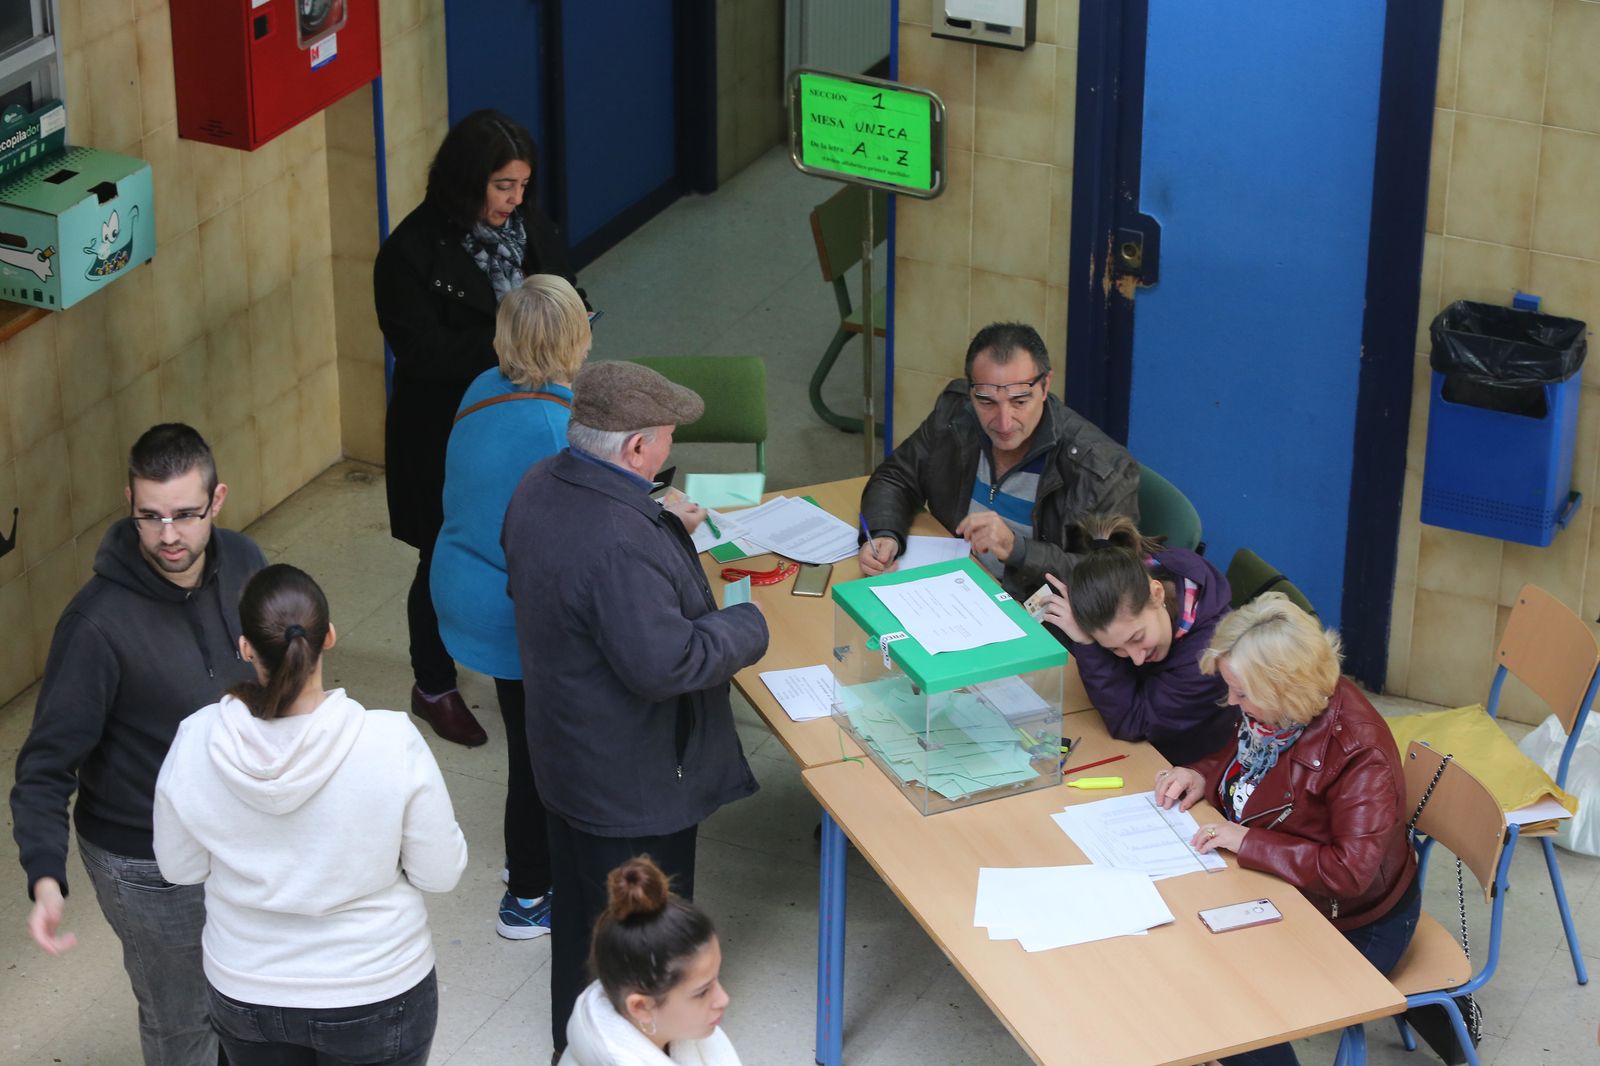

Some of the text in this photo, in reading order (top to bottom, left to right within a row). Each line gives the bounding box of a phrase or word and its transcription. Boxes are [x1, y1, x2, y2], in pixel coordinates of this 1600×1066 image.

[871, 92, 886, 110] 1
[0, 124, 39, 152] copilador
[810, 112, 908, 141] MESA UNICA
[852, 141, 868, 159] A
[896, 149, 909, 167] Z
